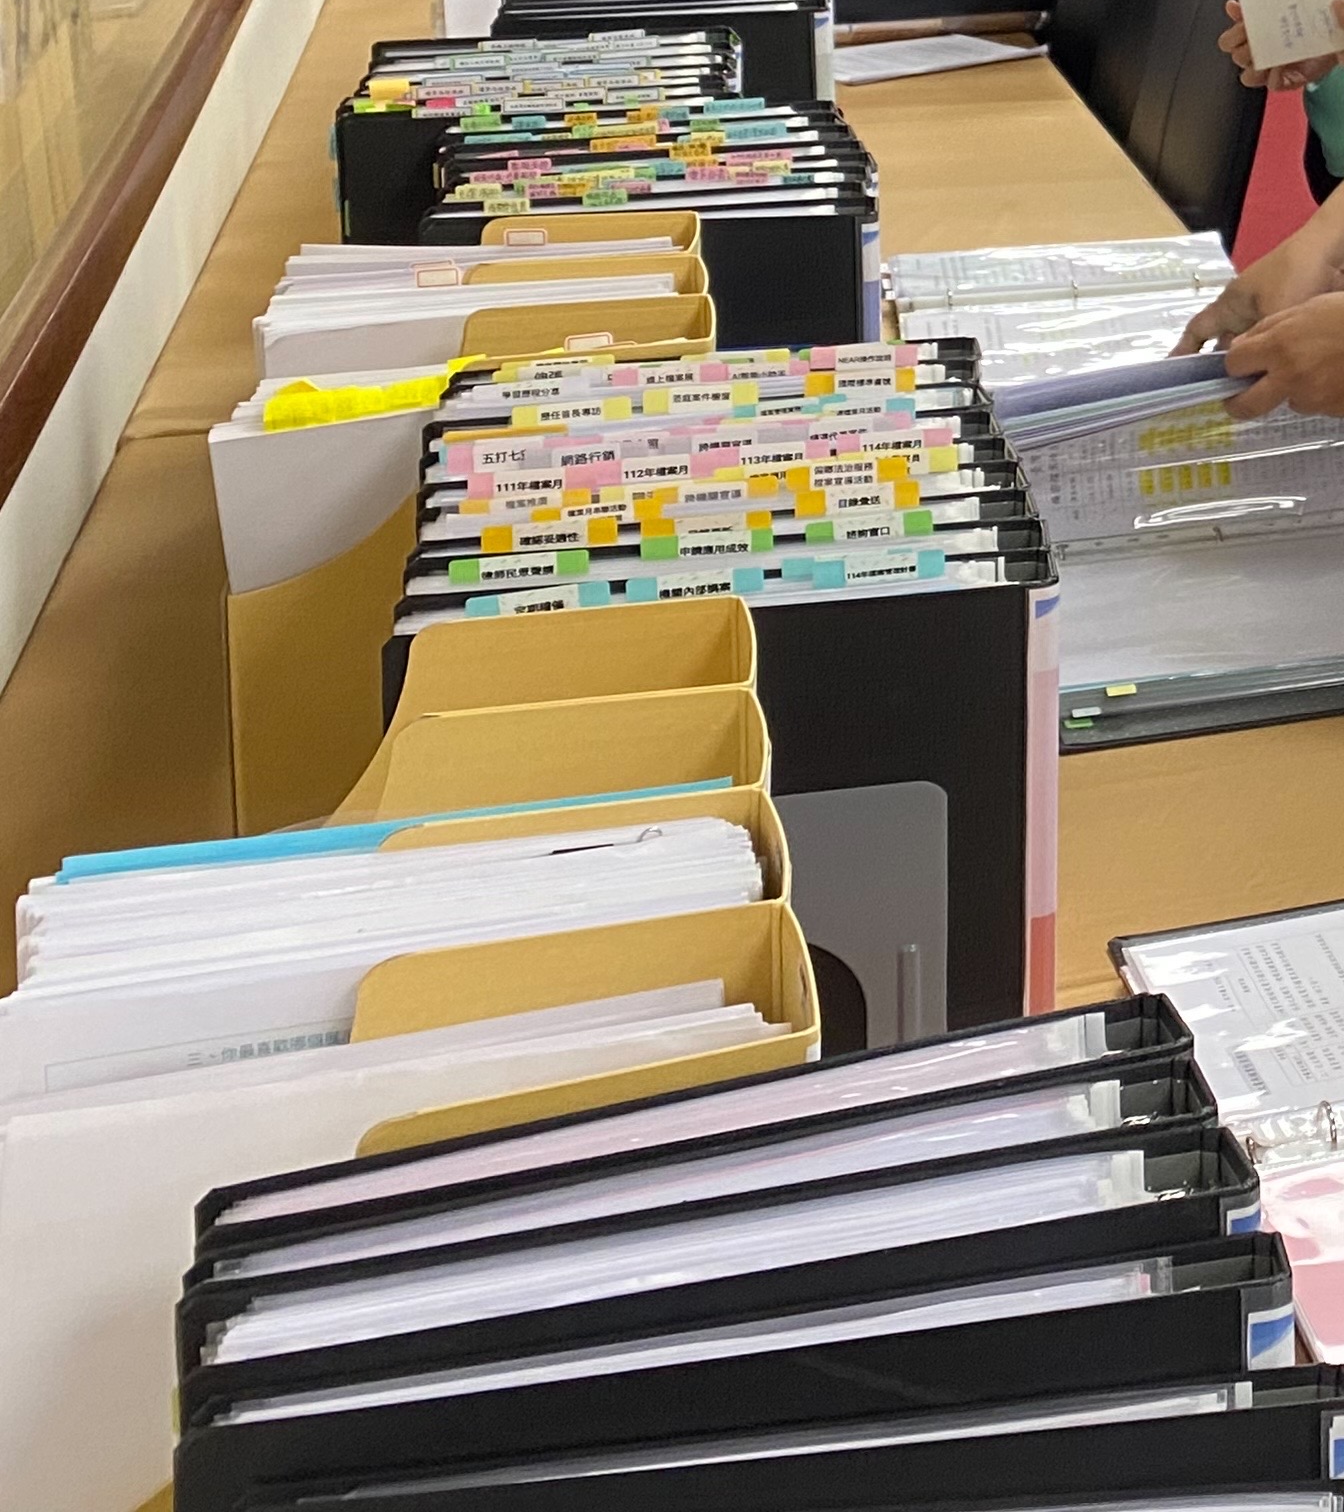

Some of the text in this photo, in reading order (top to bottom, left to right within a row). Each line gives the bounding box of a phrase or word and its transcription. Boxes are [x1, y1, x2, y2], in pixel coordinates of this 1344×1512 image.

[646, 372, 694, 384] 線上檔案展
[862, 439, 923, 452] 114年檔案月
[561, 450, 616, 467] 網路行銷
[741, 452, 804, 465] 113年檔案月
[624, 464, 689, 479] 112年檔案月
[496, 478, 563, 492] 111年檔案月
